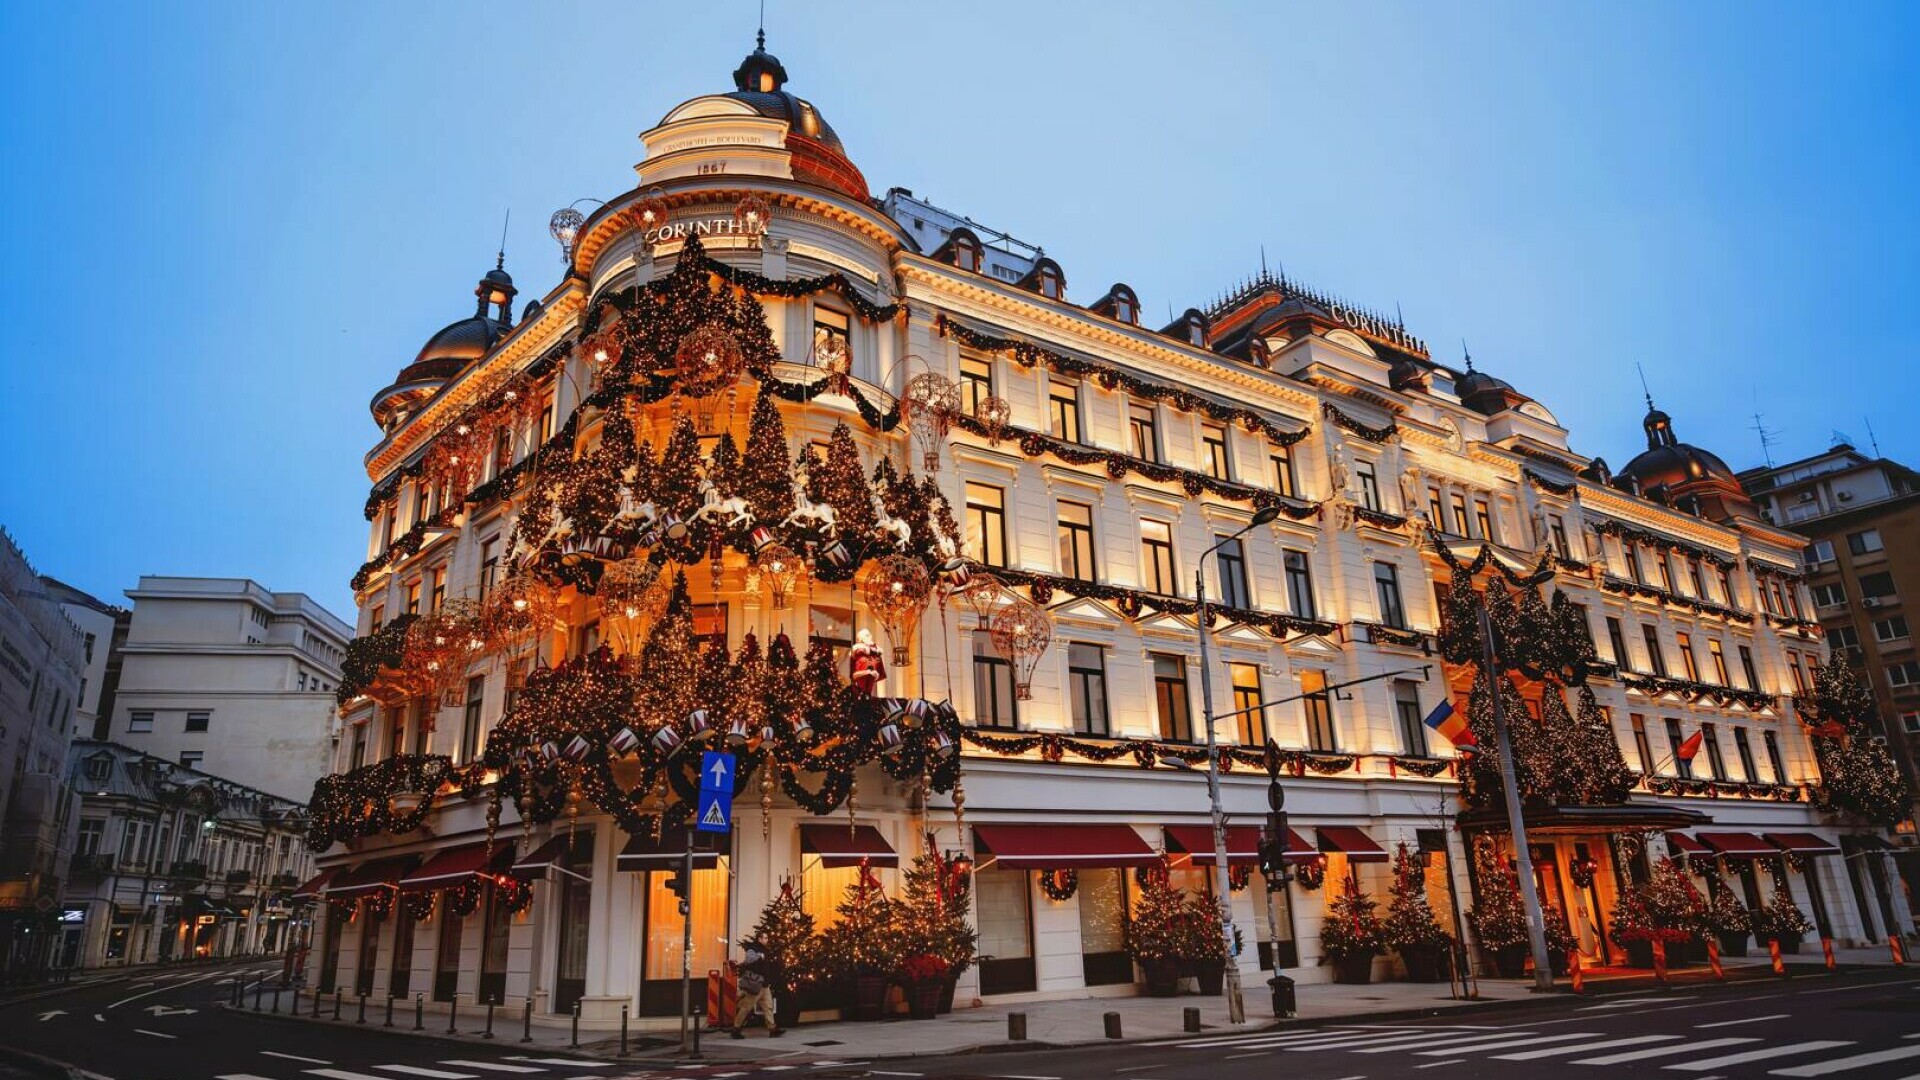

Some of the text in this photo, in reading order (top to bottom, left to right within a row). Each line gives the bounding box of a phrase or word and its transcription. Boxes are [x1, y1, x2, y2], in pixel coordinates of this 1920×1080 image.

[697, 161, 727, 175] 1867
[645, 219, 769, 243] CORINTHIA
[1331, 304, 1430, 356] CORINTHIA
